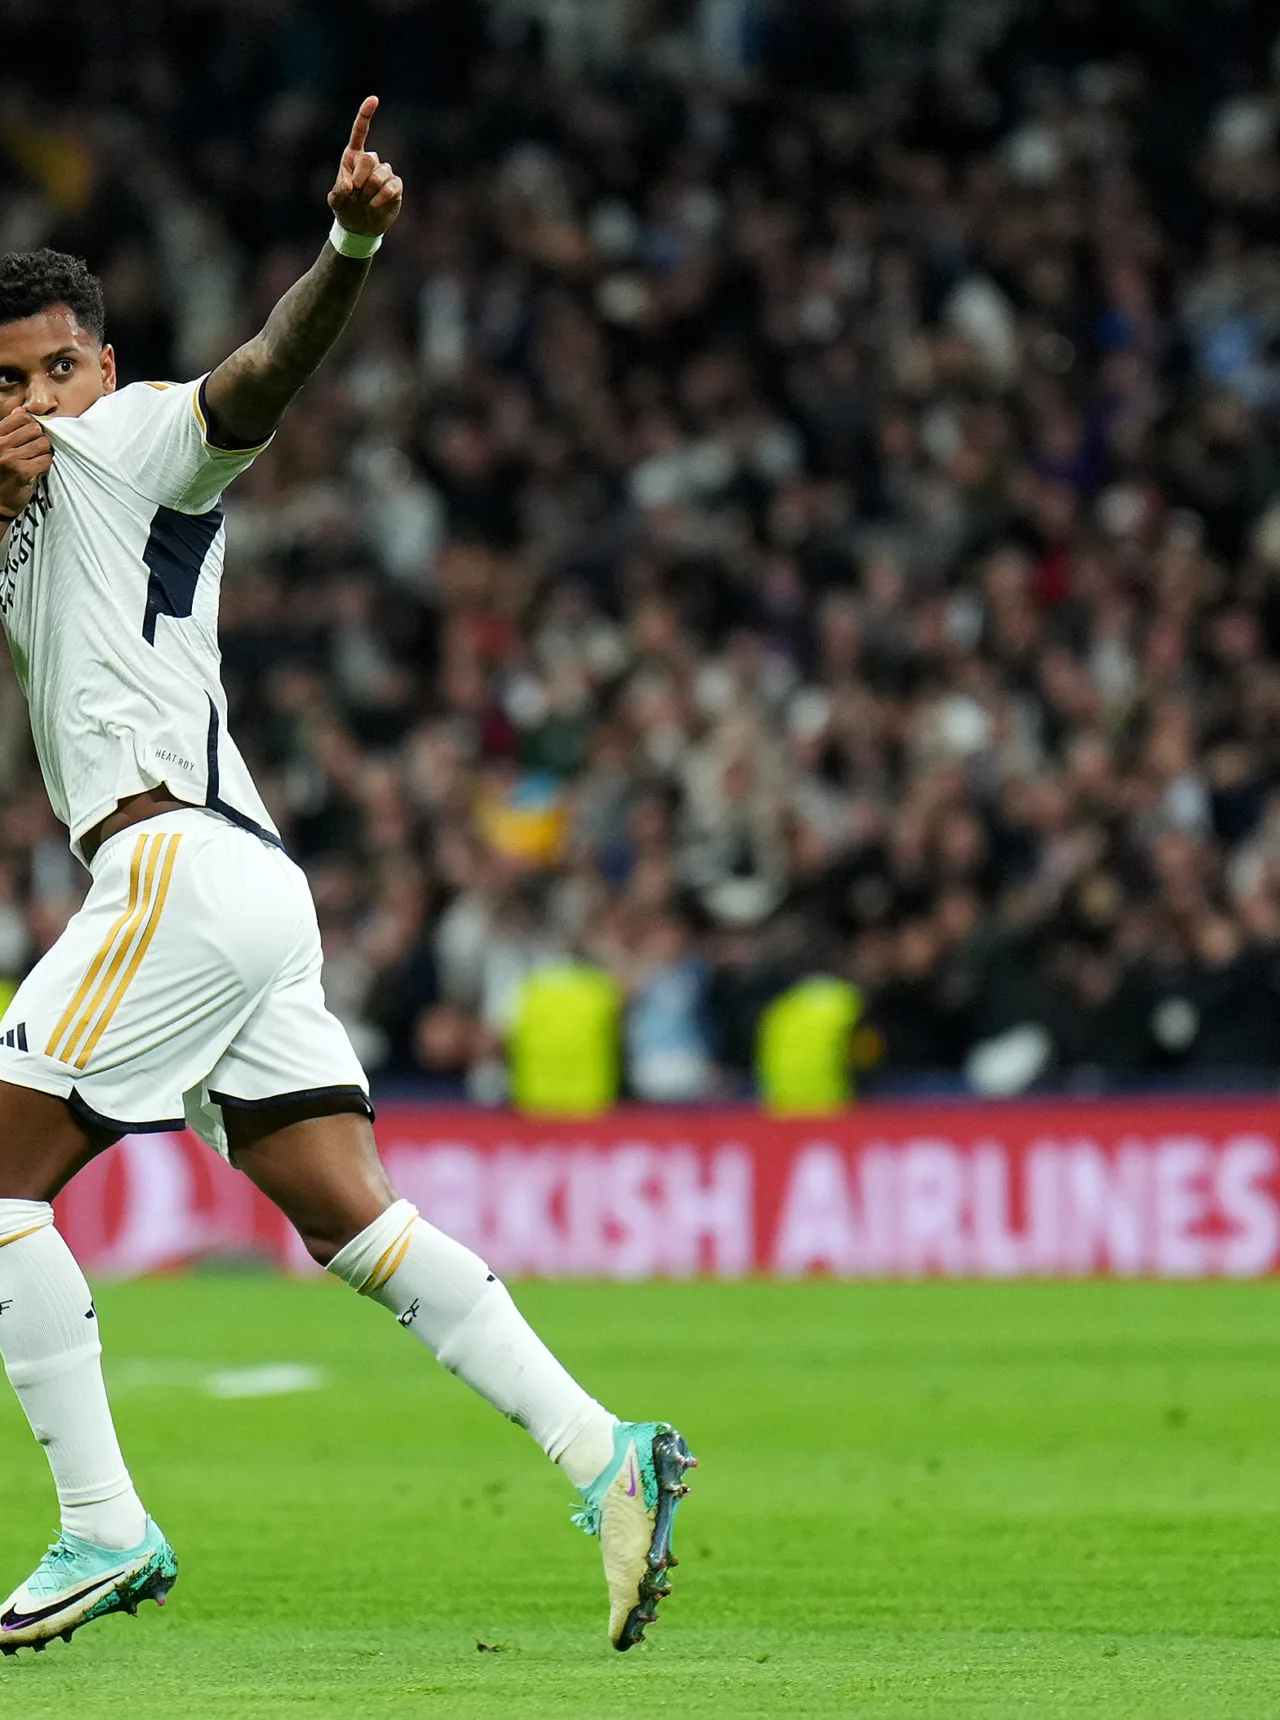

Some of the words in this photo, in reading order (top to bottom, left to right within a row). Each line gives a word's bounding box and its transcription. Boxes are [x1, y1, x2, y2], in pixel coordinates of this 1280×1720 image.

[154, 748, 196, 772] HEAT.RDY
[287, 1141, 753, 1278] RKISH
[775, 1136, 1279, 1277] AIRLINES
[398, 1298, 420, 1328] CF
